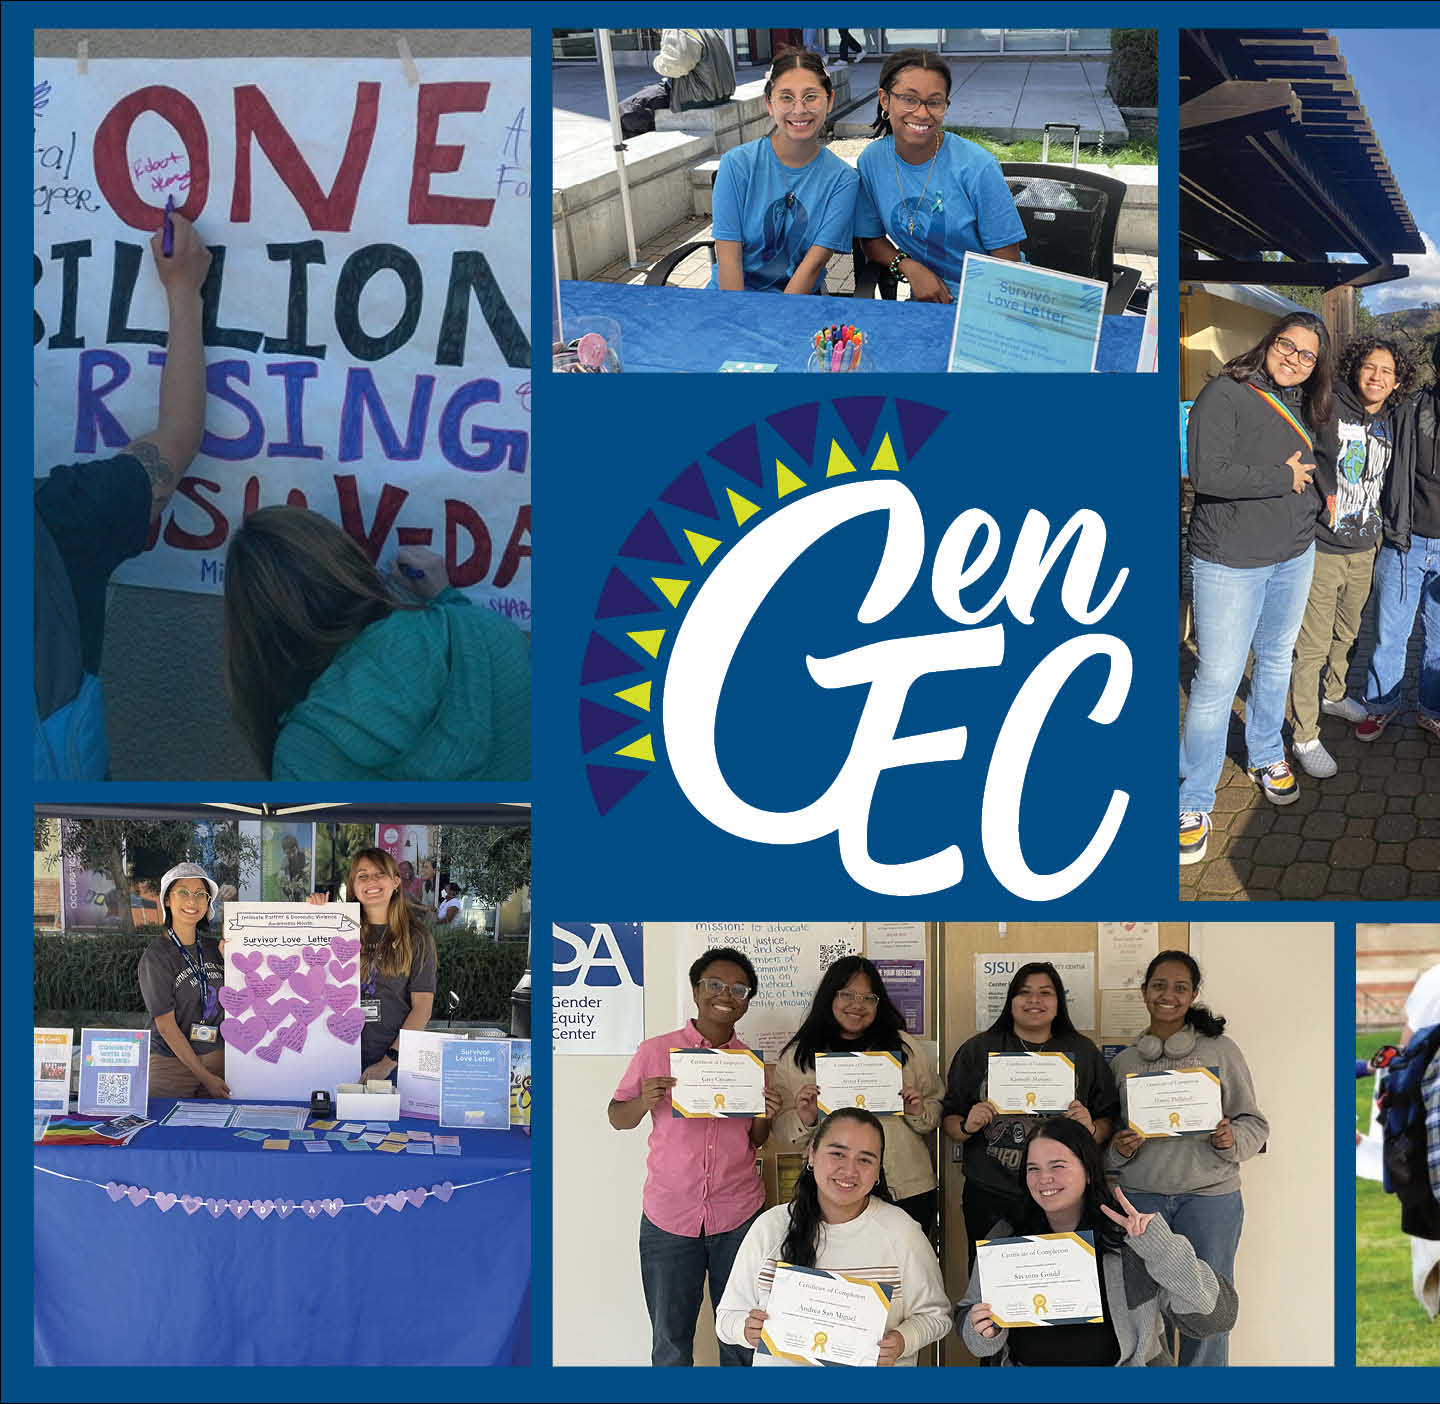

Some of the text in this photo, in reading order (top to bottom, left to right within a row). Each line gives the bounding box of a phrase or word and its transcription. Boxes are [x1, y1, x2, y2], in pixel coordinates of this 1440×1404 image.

[93, 81, 496, 232] ONE
[1000, 281, 1056, 305] Survivor
[987, 291, 1066, 325] Love Letter
[695, 921, 745, 932] mission:
[724, 935, 751, 944] social
[775, 946, 801, 955] safety
[984, 961, 1015, 975] SJSU
[553, 996, 602, 1008] Gender
[553, 1028, 597, 1040] Center
